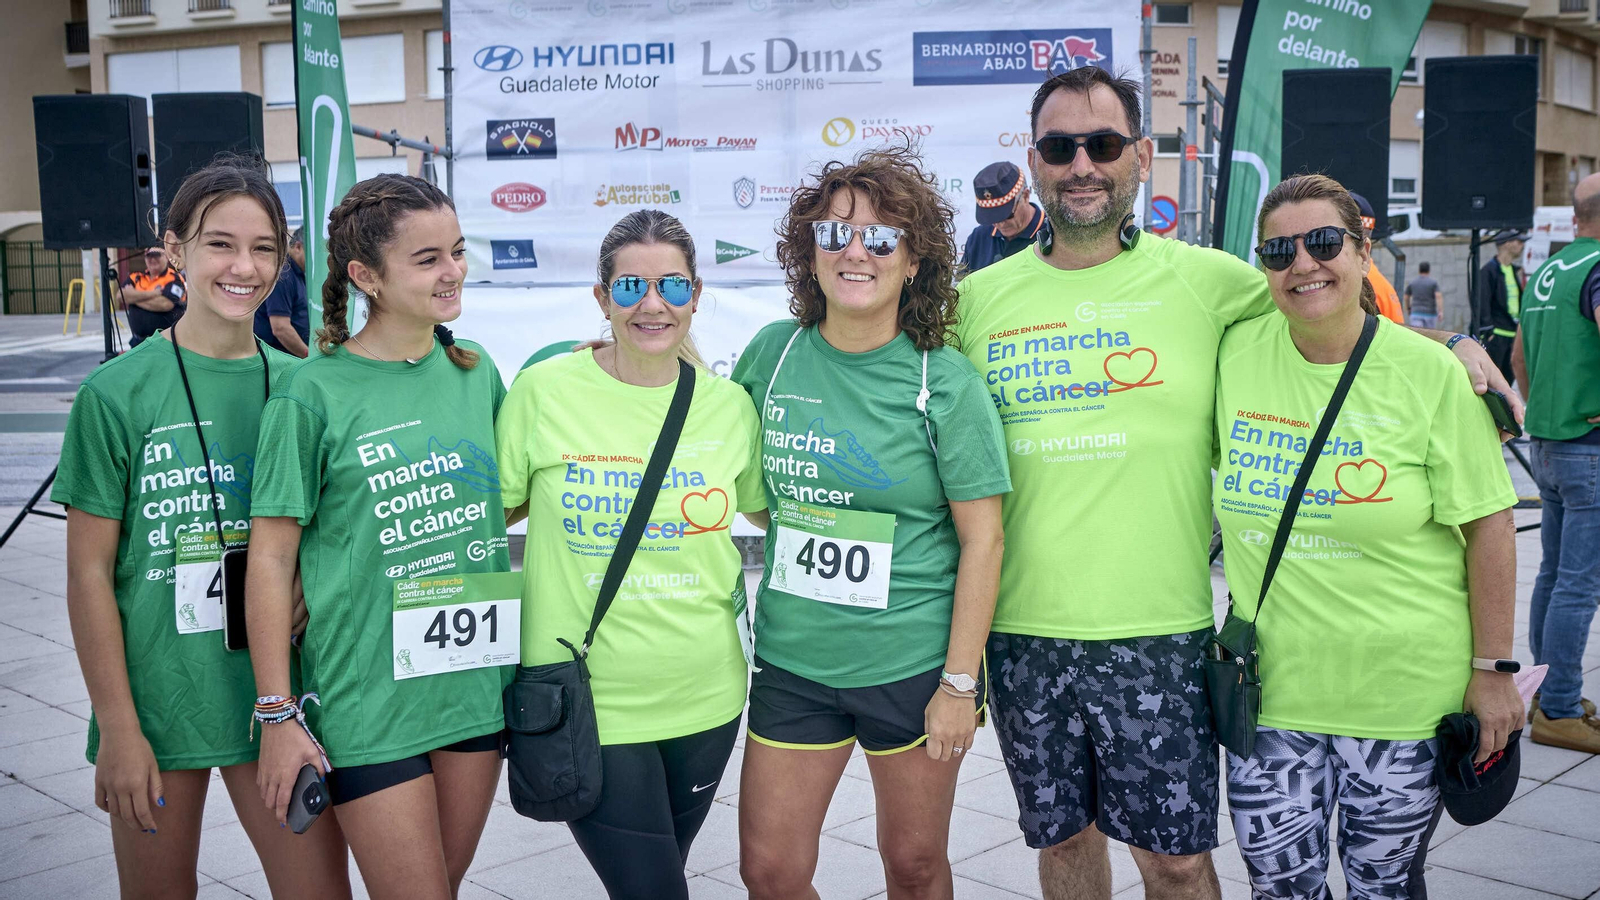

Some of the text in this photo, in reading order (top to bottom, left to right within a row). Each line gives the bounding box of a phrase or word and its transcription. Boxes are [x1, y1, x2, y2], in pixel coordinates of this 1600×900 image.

[1283, 10, 1322, 32] por
[533, 43, 675, 68] HYUNDAI
[921, 42, 1026, 57] BERNARDINO
[1278, 34, 1360, 69] delante
[983, 58, 1027, 70] ABAD
[500, 73, 660, 94] Guadalete Motor
[756, 77, 824, 91] SHOPPING
[490, 121, 553, 140] SPAGNOLO
[615, 121, 661, 149] MP
[665, 137, 758, 149] MOTOS PAYAN
[496, 191, 542, 204] PEDRO
[989, 321, 1067, 341] IX CÁDIZ EN MARCHA
[987, 328, 1131, 364] En marcha
[986, 357, 1072, 386] contra
[992, 380, 1114, 408] el cáncer
[1020, 408, 1048, 416] ESPAÑOLA
[1237, 409, 1310, 429] IX CÁDIZ EN MARCHA
[764, 430, 836, 455] marcha
[1041, 432, 1127, 452] HYUNDAI
[1230, 419, 1363, 456] En macha
[144, 441, 172, 467] En
[357, 441, 396, 468] En
[571, 454, 596, 463] CÁDIZ
[610, 456, 644, 464] MARCHA
[1042, 450, 1127, 463] Guadalete Motor
[141, 459, 236, 494] marcha
[367, 451, 463, 493] marcha
[564, 462, 706, 490] En macha
[763, 454, 819, 479] contra
[1224, 471, 1242, 493] el
[143, 489, 226, 520] contra
[374, 482, 455, 519] contra
[562, 491, 633, 514] contr
[781, 501, 799, 511] Cádiz
[809, 508, 836, 518] marcha
[1247, 502, 1277, 513] ESPAÑOLA
[379, 501, 487, 546] el cáncer
[563, 514, 690, 540] el cácer
[782, 510, 803, 520] contra
[811, 516, 836, 527] cáncer
[148, 521, 170, 547] el
[180, 534, 203, 544] Cádiz
[182, 543, 209, 552] contra
[1281, 550, 1363, 560] uadalete Motor
[407, 550, 455, 572] HYUNDAI
[438, 562, 456, 572] Motor
[796, 537, 870, 583] 490
[397, 581, 420, 590] Cádiz
[433, 578, 463, 586] marcha
[620, 573, 700, 588] HYUNDAI
[399, 585, 464, 599] contra el cáncer
[424, 604, 498, 649] 491
